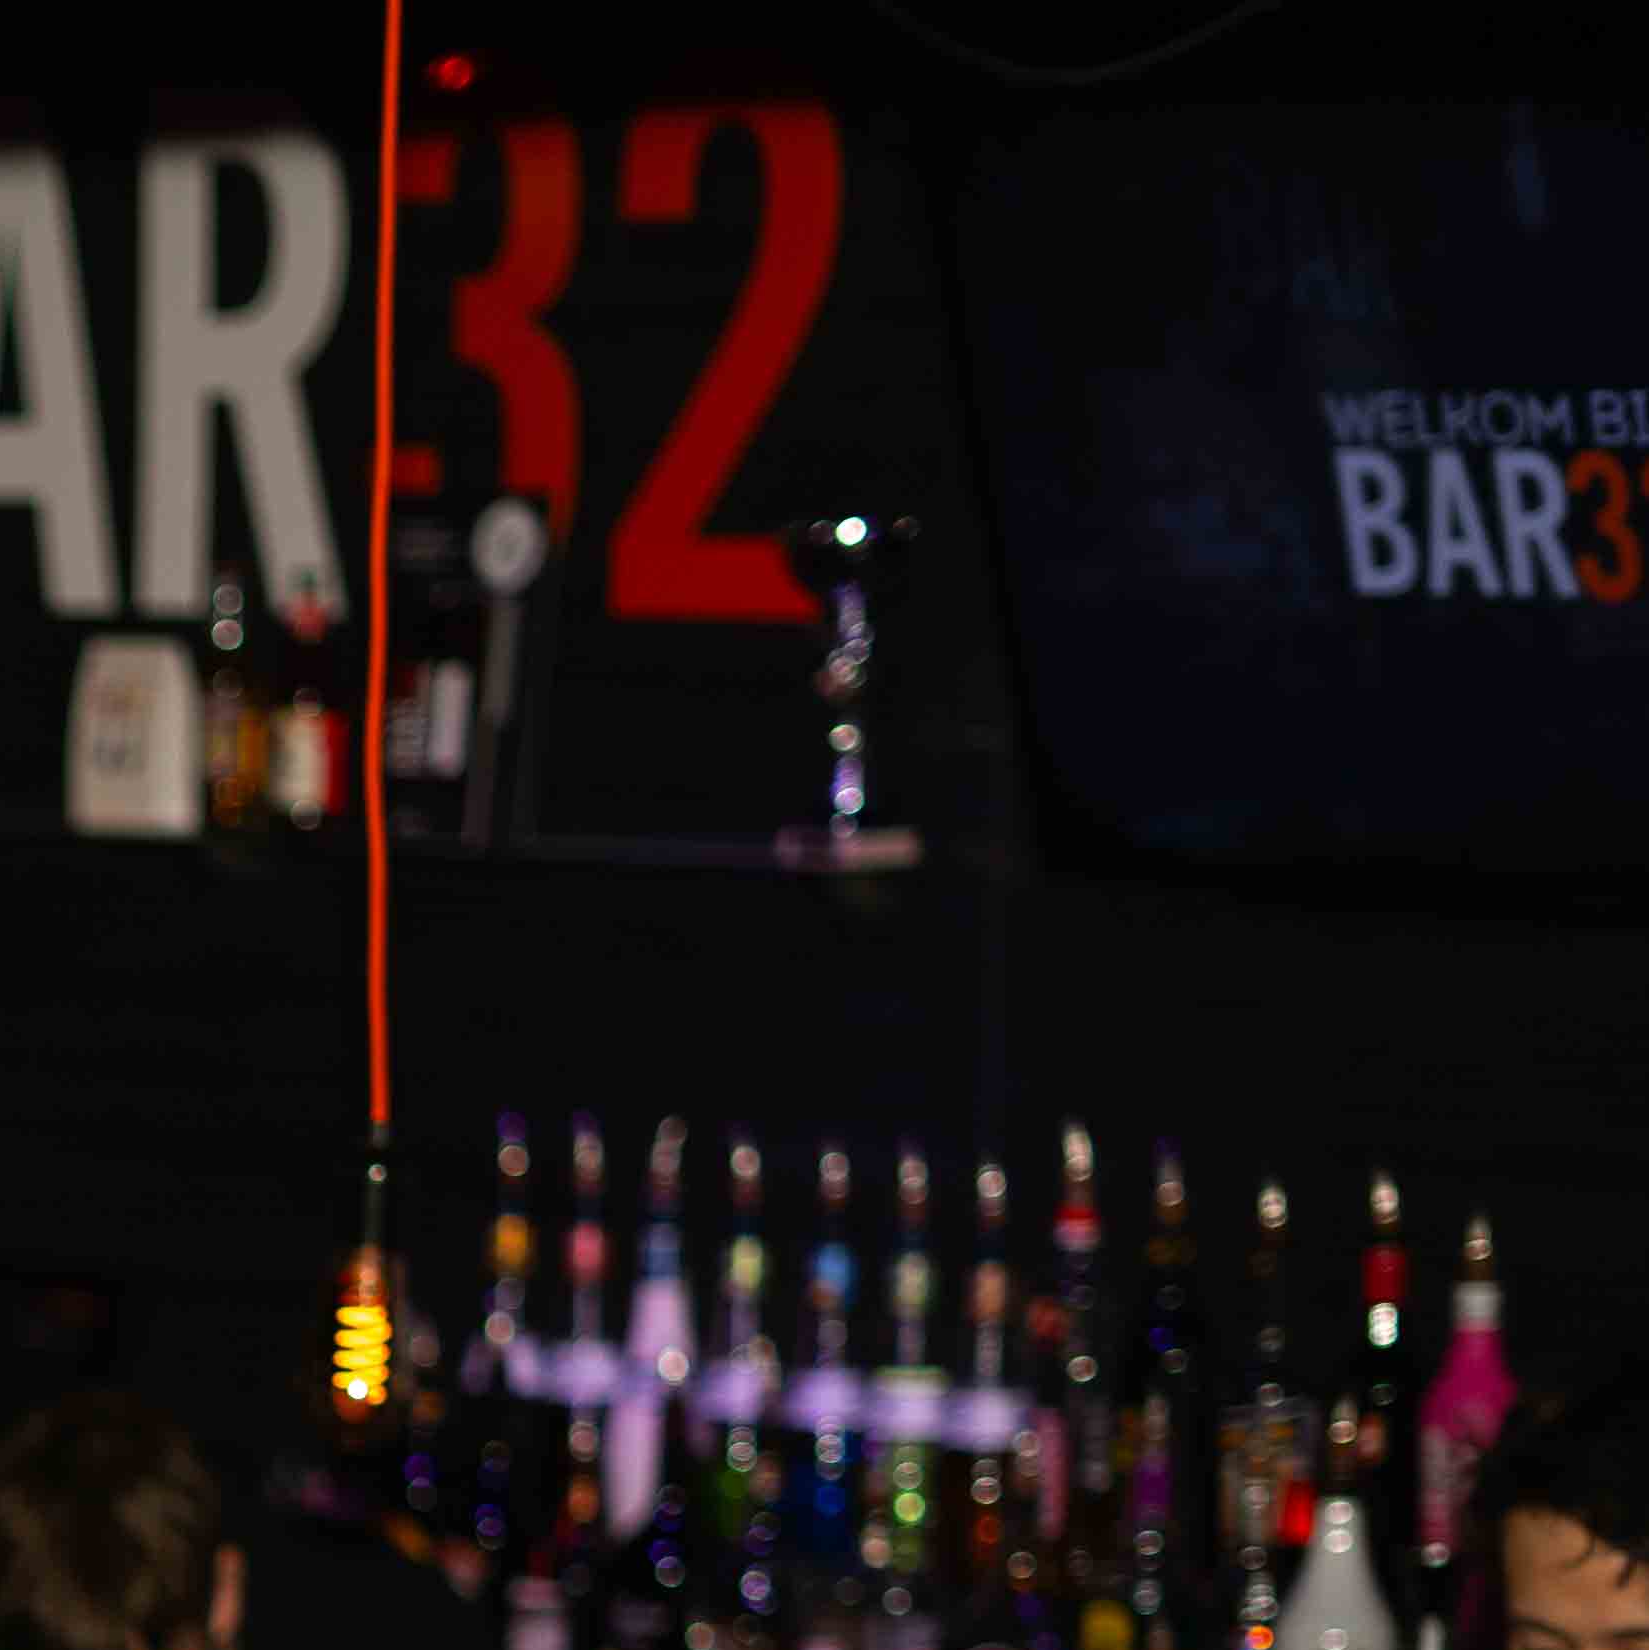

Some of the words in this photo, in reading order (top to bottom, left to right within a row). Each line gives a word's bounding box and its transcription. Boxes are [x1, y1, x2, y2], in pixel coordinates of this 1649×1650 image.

[1322, 388, 1576, 449] WELKOM
[1587, 387, 1649, 449] BI
[1333, 447, 1649, 602] BAR3
